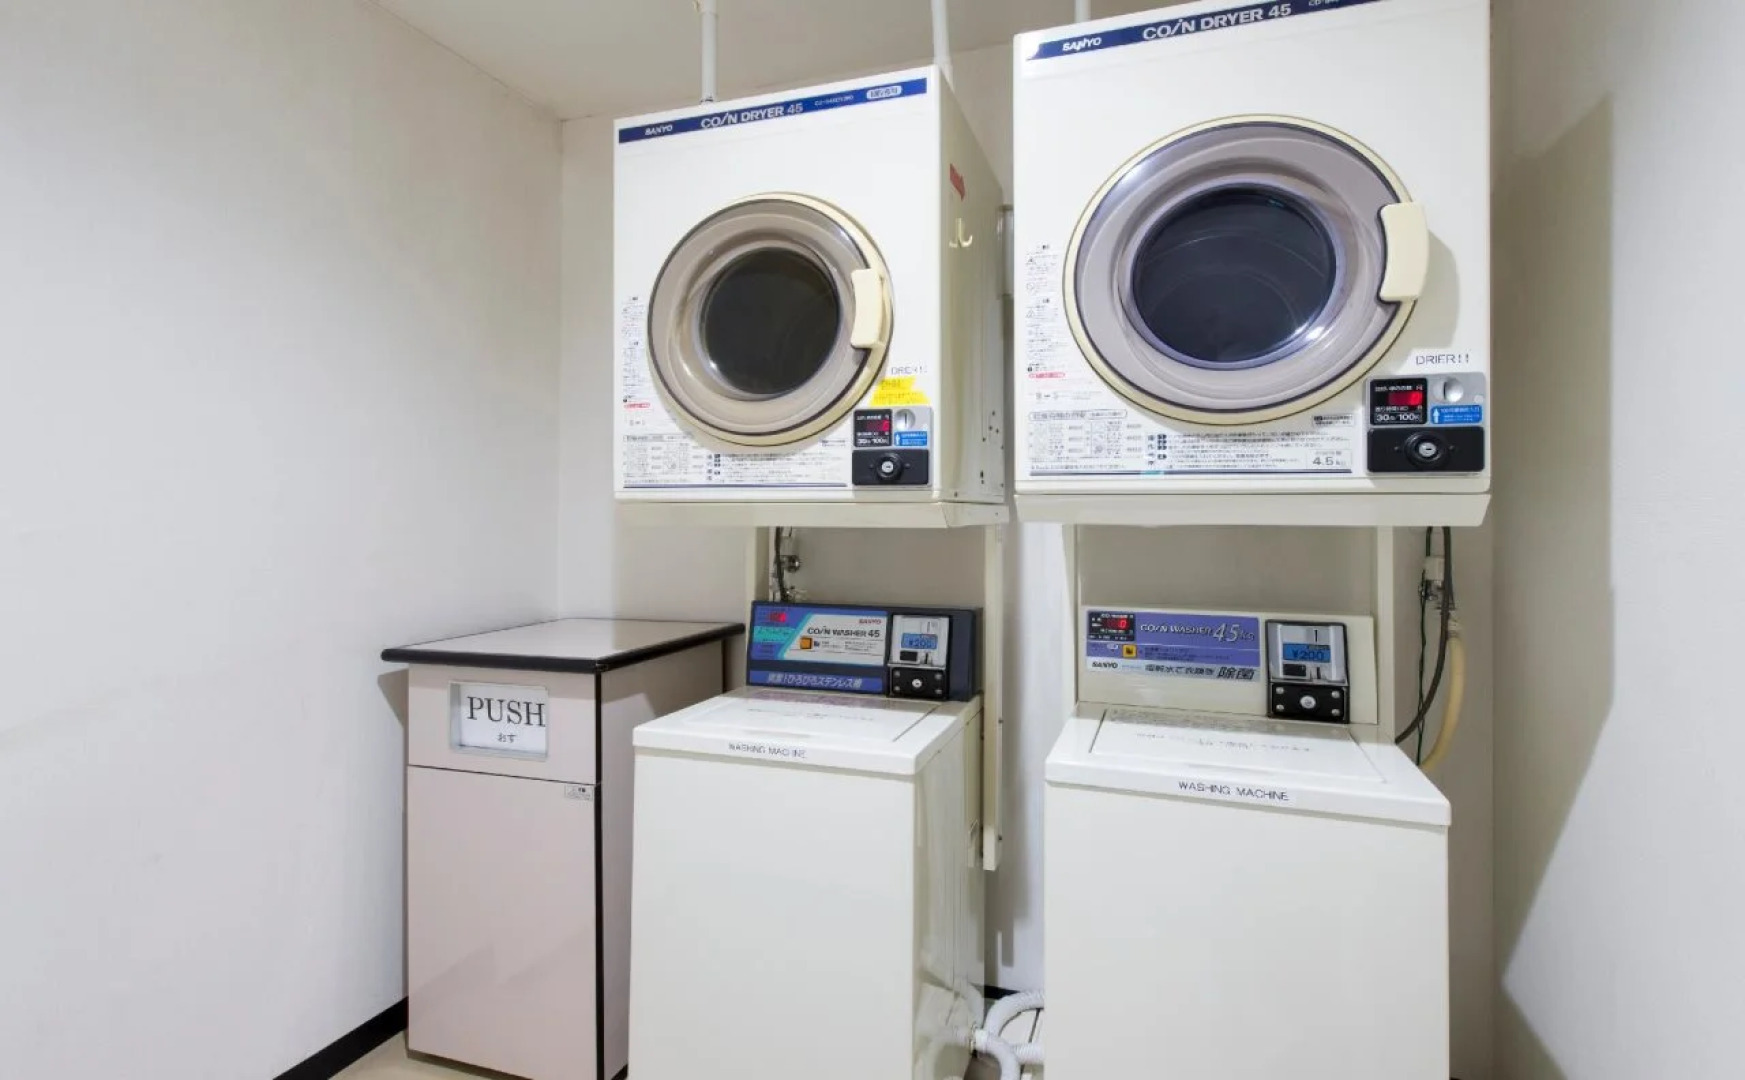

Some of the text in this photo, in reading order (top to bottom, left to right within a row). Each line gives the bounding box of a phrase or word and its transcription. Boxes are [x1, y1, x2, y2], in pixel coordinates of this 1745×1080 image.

[1062, 37, 1102, 52] SANYO
[1200, 7, 1264, 31] DRYER
[1268, 3, 1292, 17] 45
[645, 124, 673, 136] SANYO
[741, 106, 785, 123] DRYER
[787, 103, 804, 115] 45
[833, 629, 867, 637] WASHER
[868, 630, 881, 638] 45
[1170, 625, 1212, 637] WASHER
[1291, 648, 1325, 659] ¥200
[467, 696, 546, 727] PUSH
[497, 733, 517, 743] おす
[768, 747, 807, 758] MACINE
[1178, 781, 1289, 801] WASHING MACHINE
